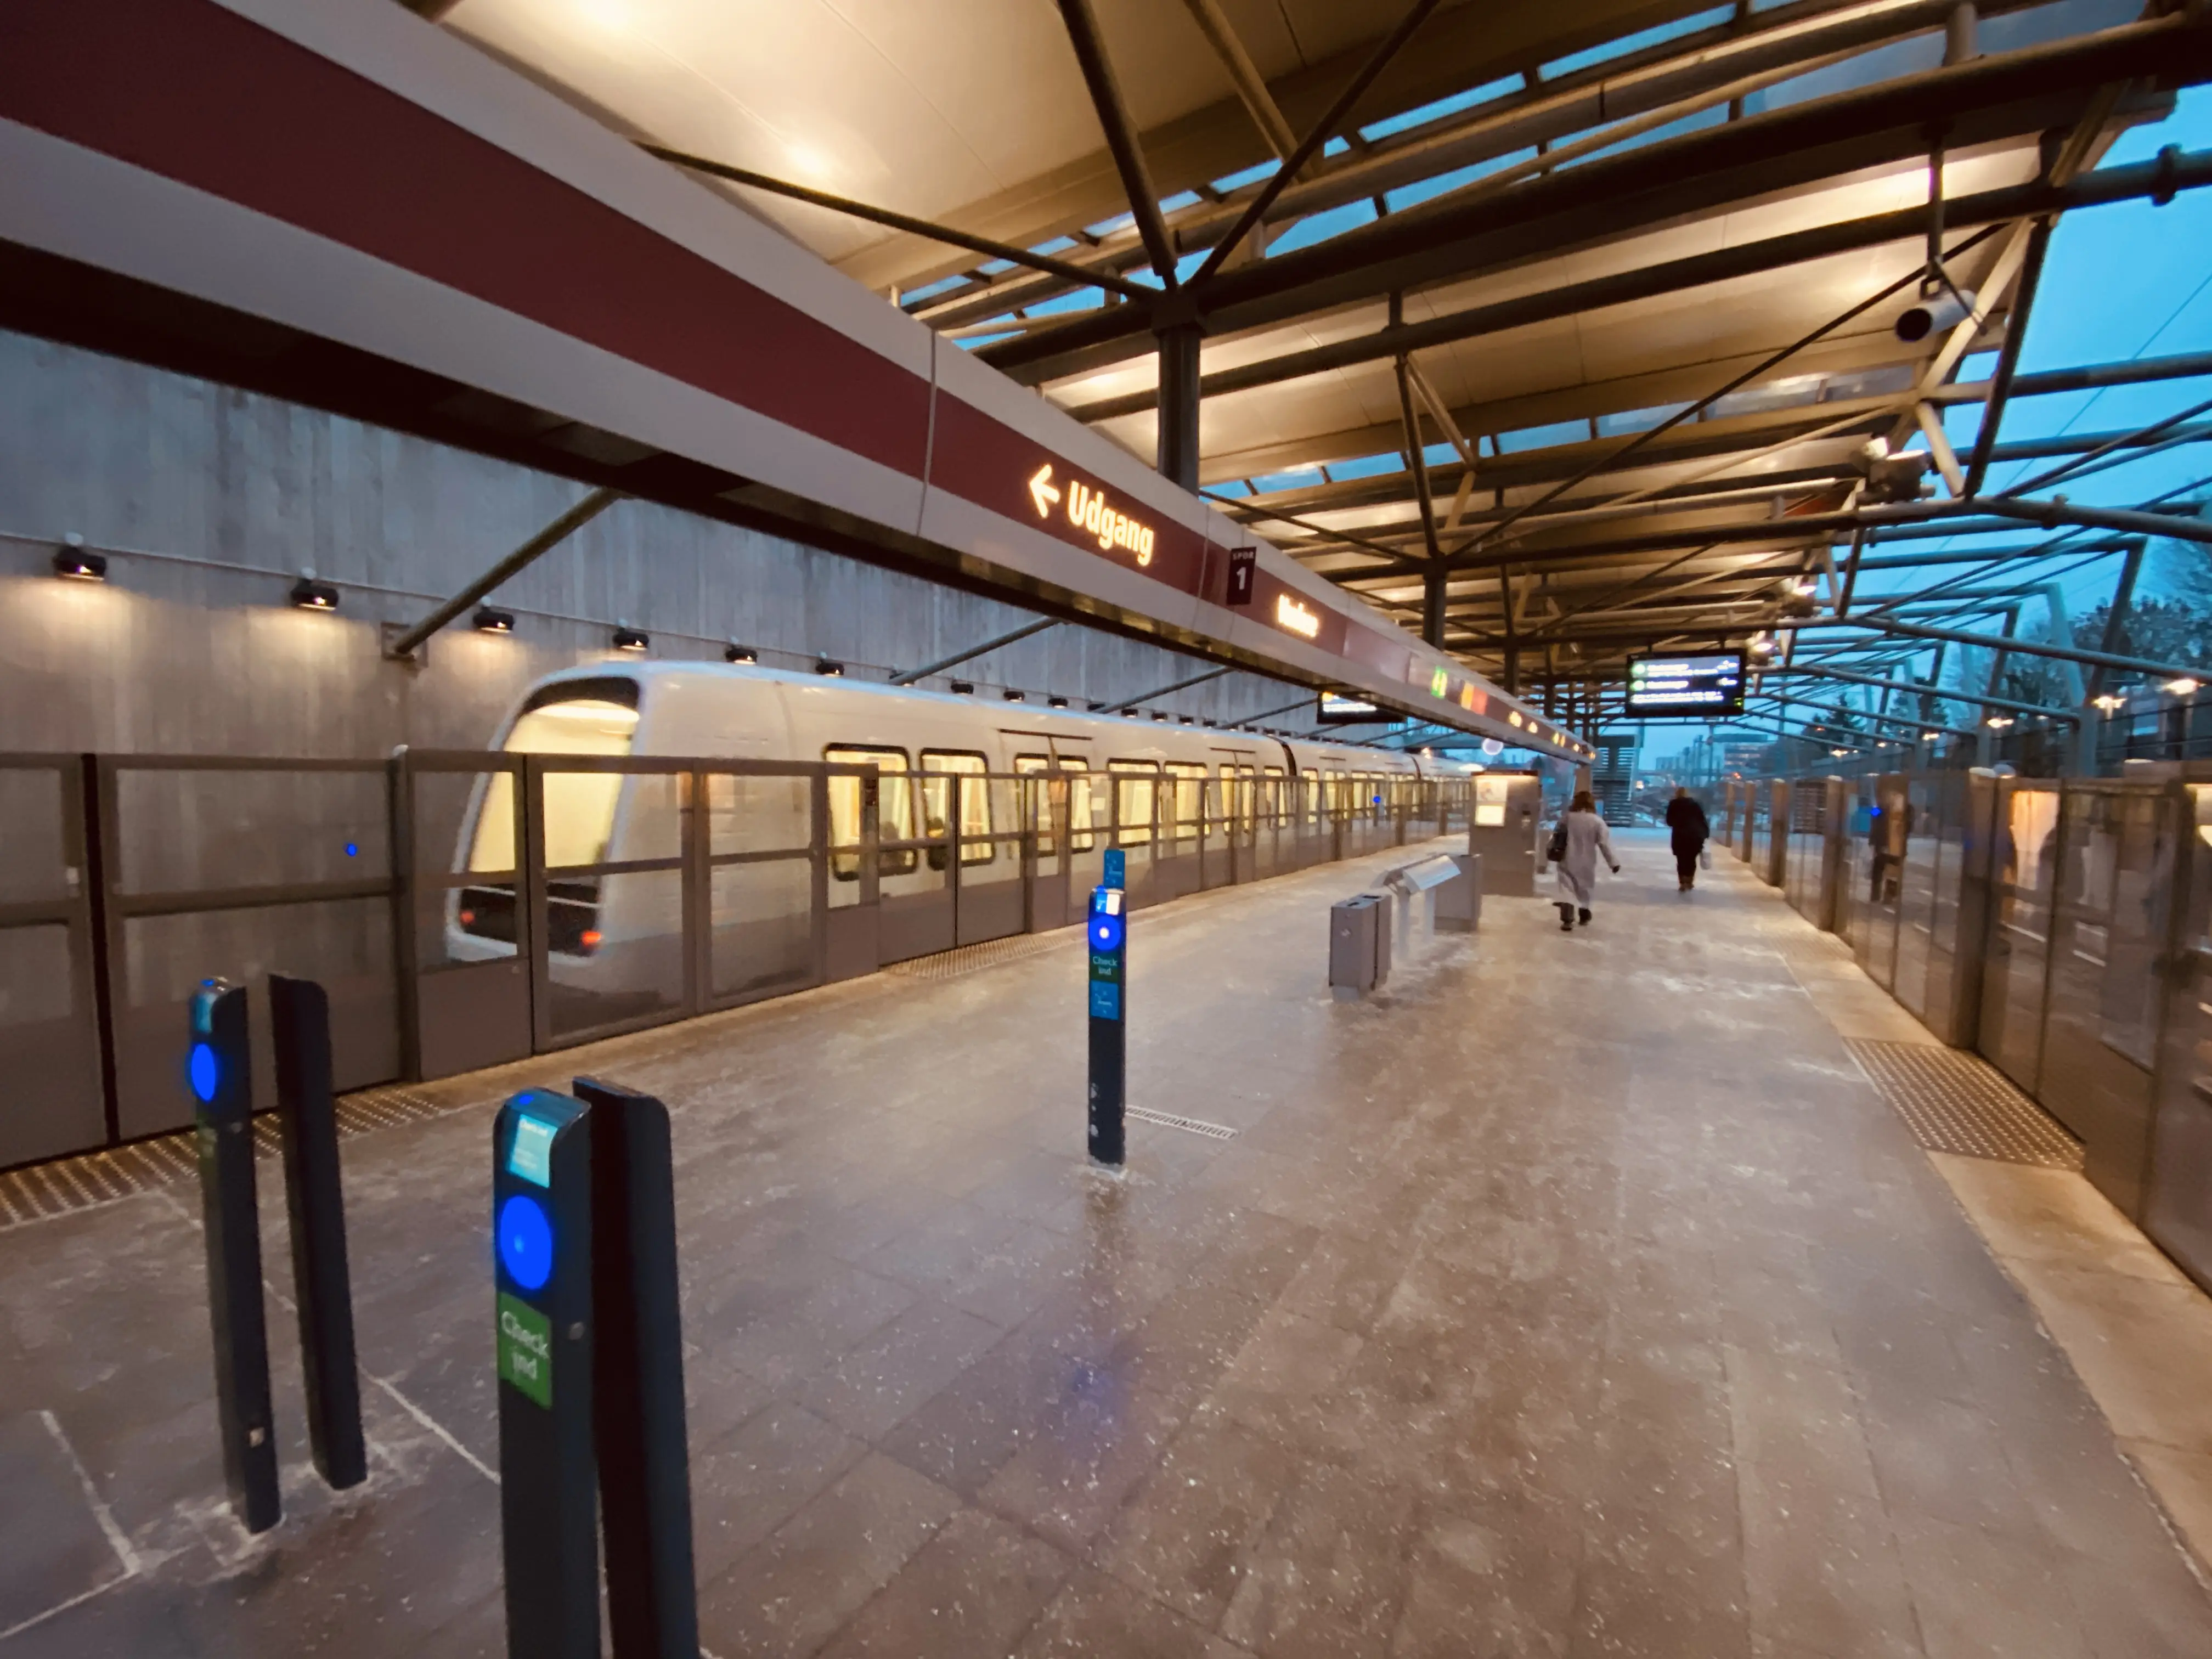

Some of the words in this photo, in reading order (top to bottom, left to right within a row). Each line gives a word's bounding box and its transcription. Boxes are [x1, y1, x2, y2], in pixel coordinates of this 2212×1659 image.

[1068, 480, 1154, 566] Udgang
[1233, 551, 1254, 560] SPOR
[1236, 567, 1246, 590] 1
[1093, 956, 1118, 966] Check
[1098, 967, 1111, 975] ind
[501, 1311, 549, 1359] Check
[509, 1346, 538, 1381] ind
